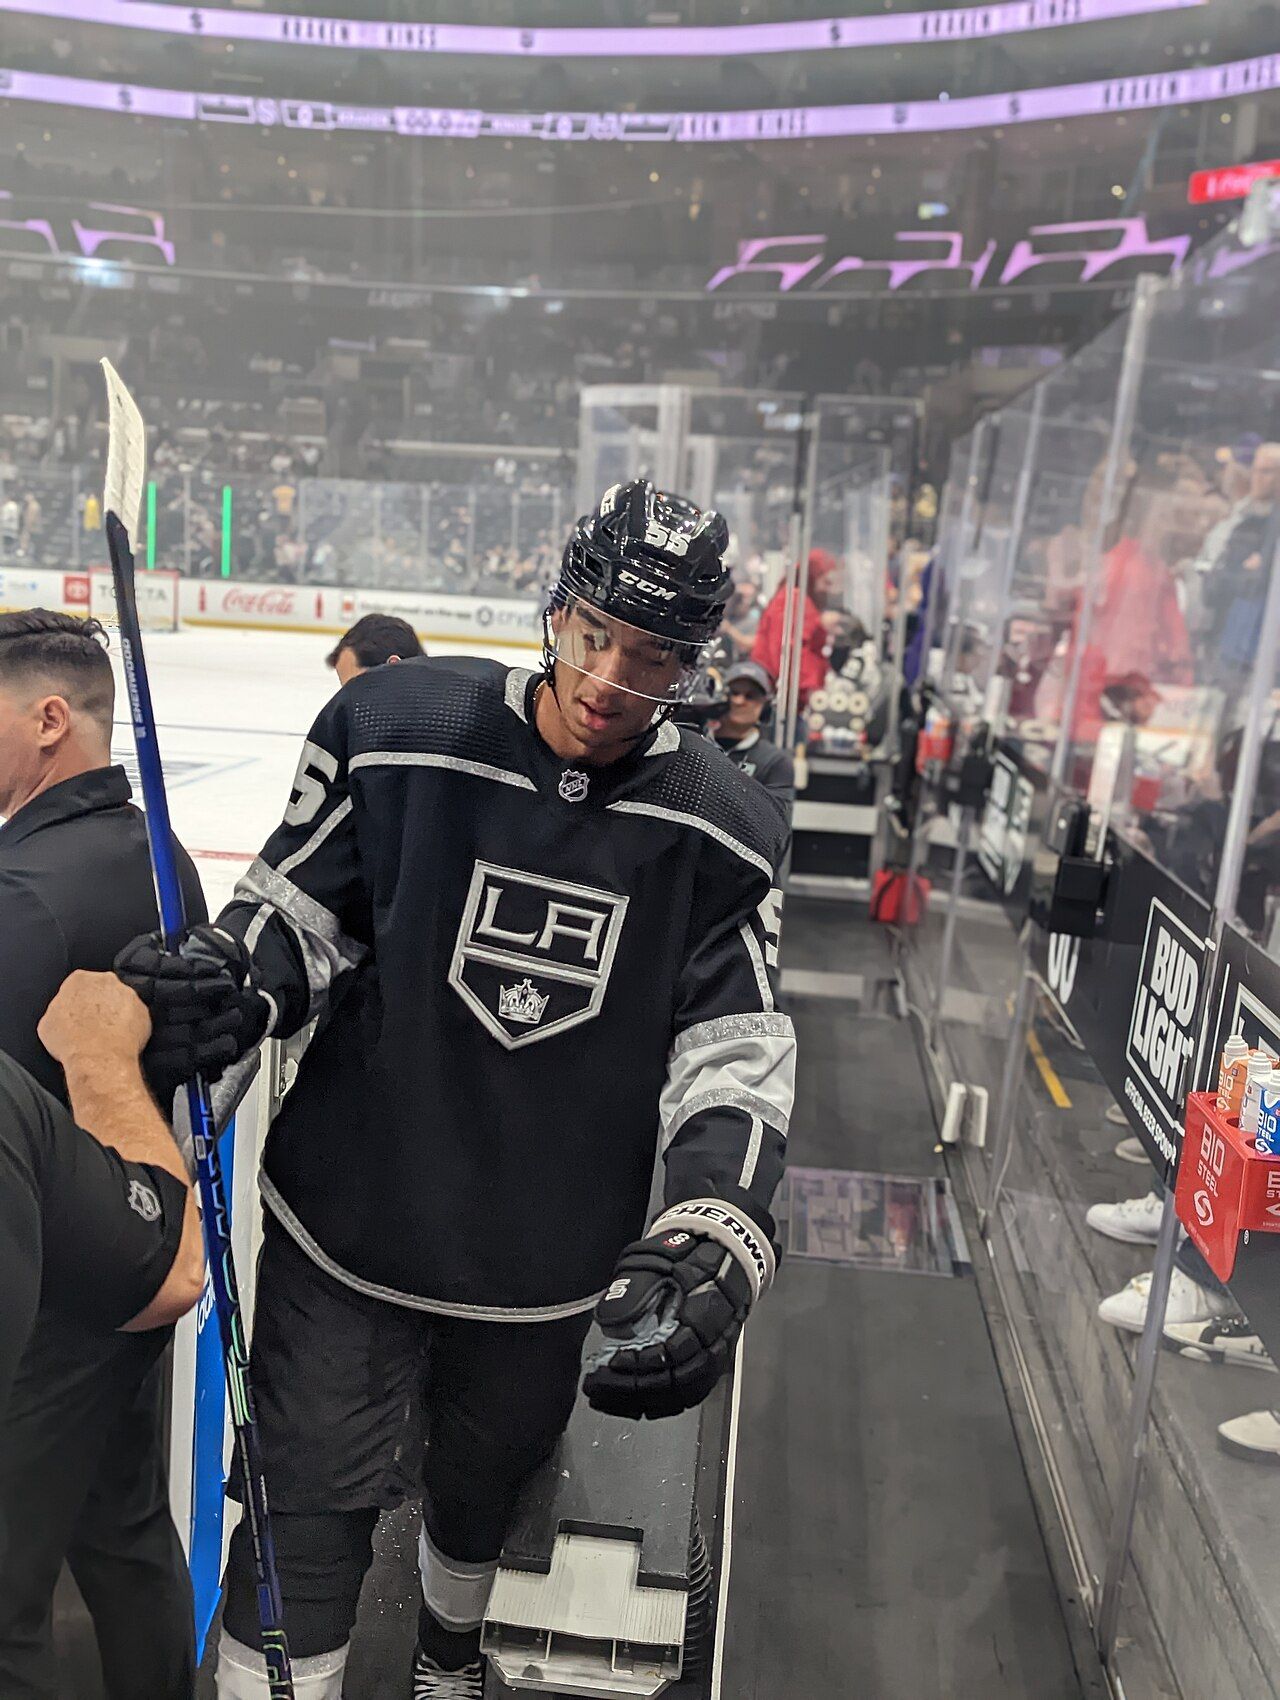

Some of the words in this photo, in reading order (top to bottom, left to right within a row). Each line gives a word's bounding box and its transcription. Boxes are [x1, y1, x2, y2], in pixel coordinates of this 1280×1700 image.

[644, 521, 692, 557] 55
[222, 585, 297, 616] Coca-Cola
[617, 569, 678, 601] CCM
[475, 884, 609, 962] LA
[1150, 925, 1199, 1028] BUD
[1132, 983, 1194, 1101] LIGHT
[1218, 1086, 1232, 1099] TEEL
[1257, 1109, 1277, 1133] BIO
[1257, 1127, 1275, 1142] TEEL
[1200, 1122, 1226, 1178] BIO
[1197, 1159, 1219, 1197] STEEL
